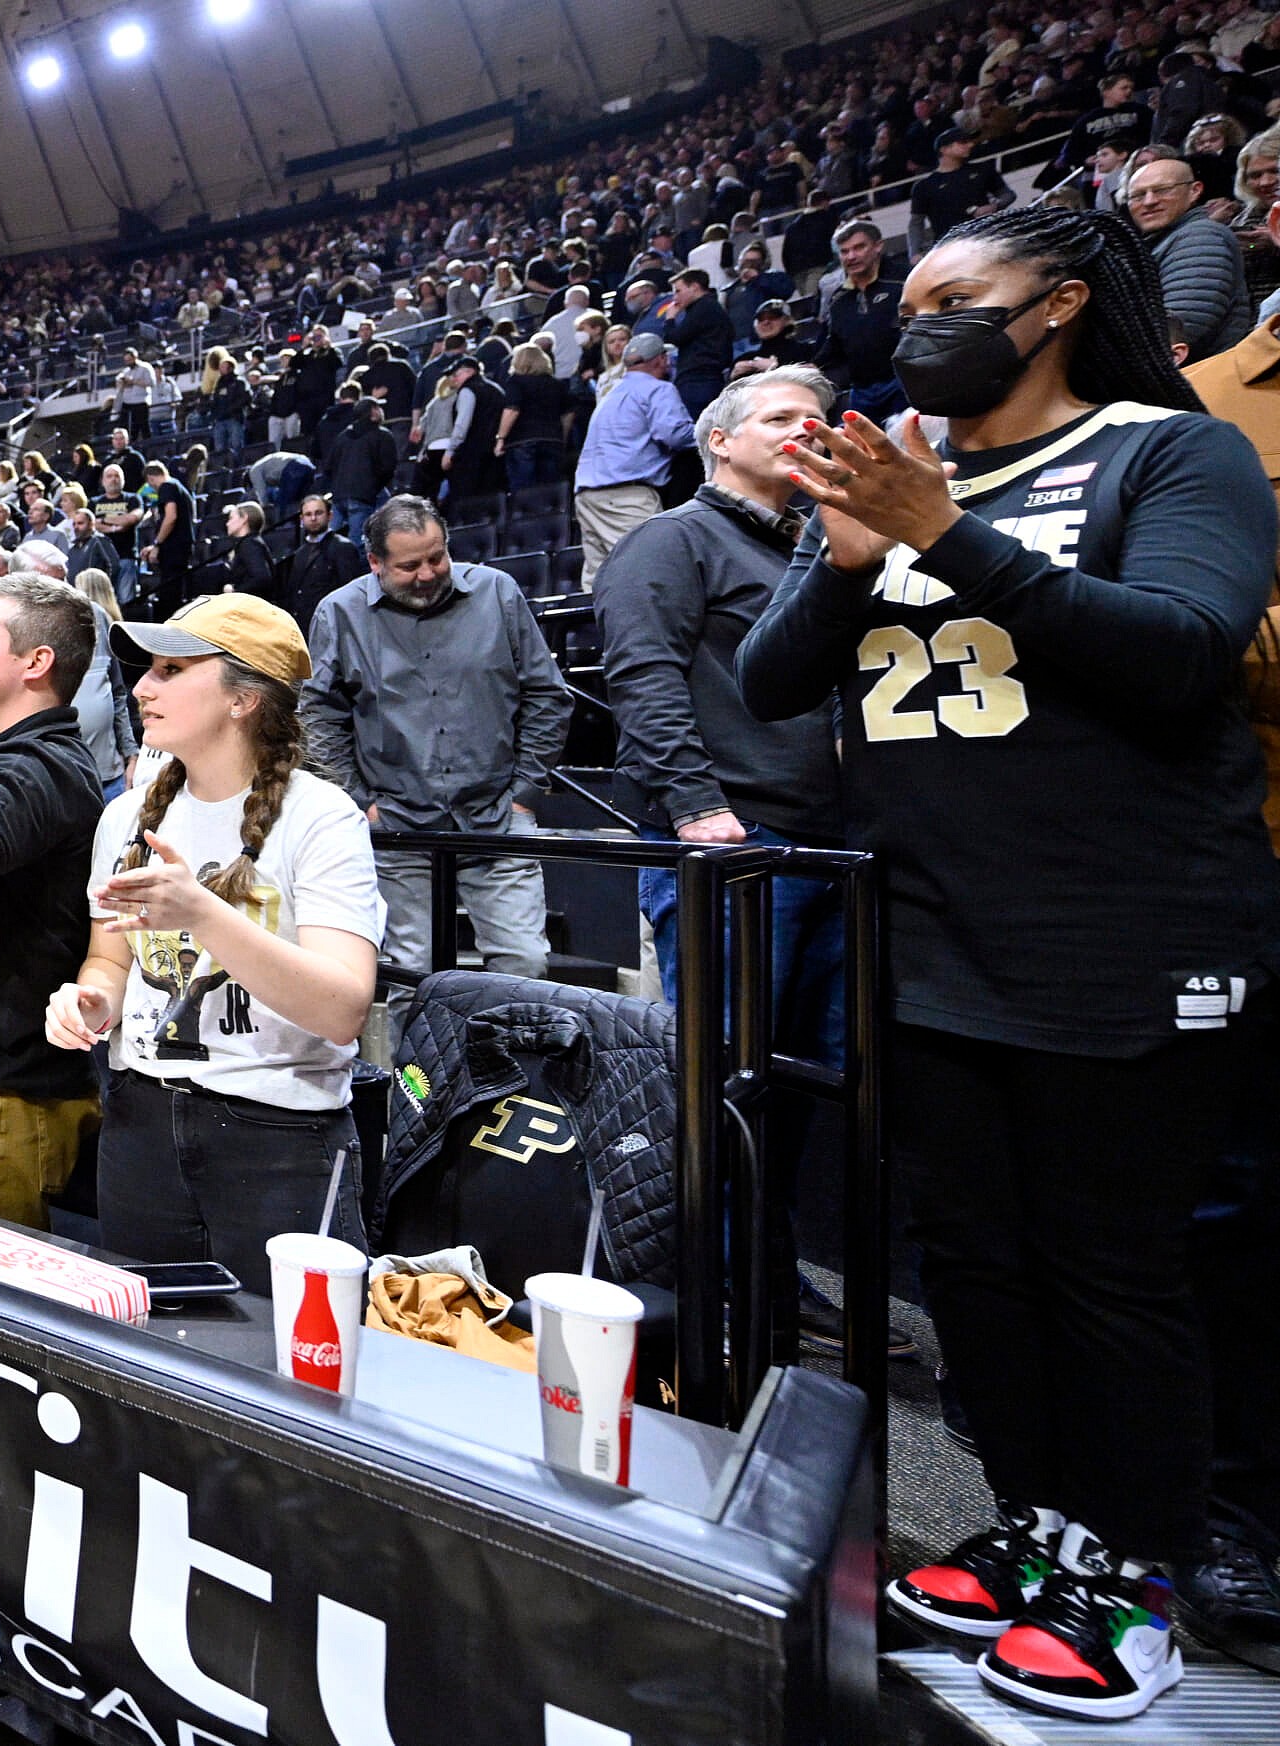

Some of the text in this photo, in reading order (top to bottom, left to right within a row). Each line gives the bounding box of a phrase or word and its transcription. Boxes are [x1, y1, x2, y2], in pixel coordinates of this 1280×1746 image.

[857, 617, 1030, 742] 23
[220, 983, 260, 1035] JR.
[1185, 977, 1220, 991] 46
[166, 1021, 180, 1041] 2
[470, 1095, 577, 1164] P
